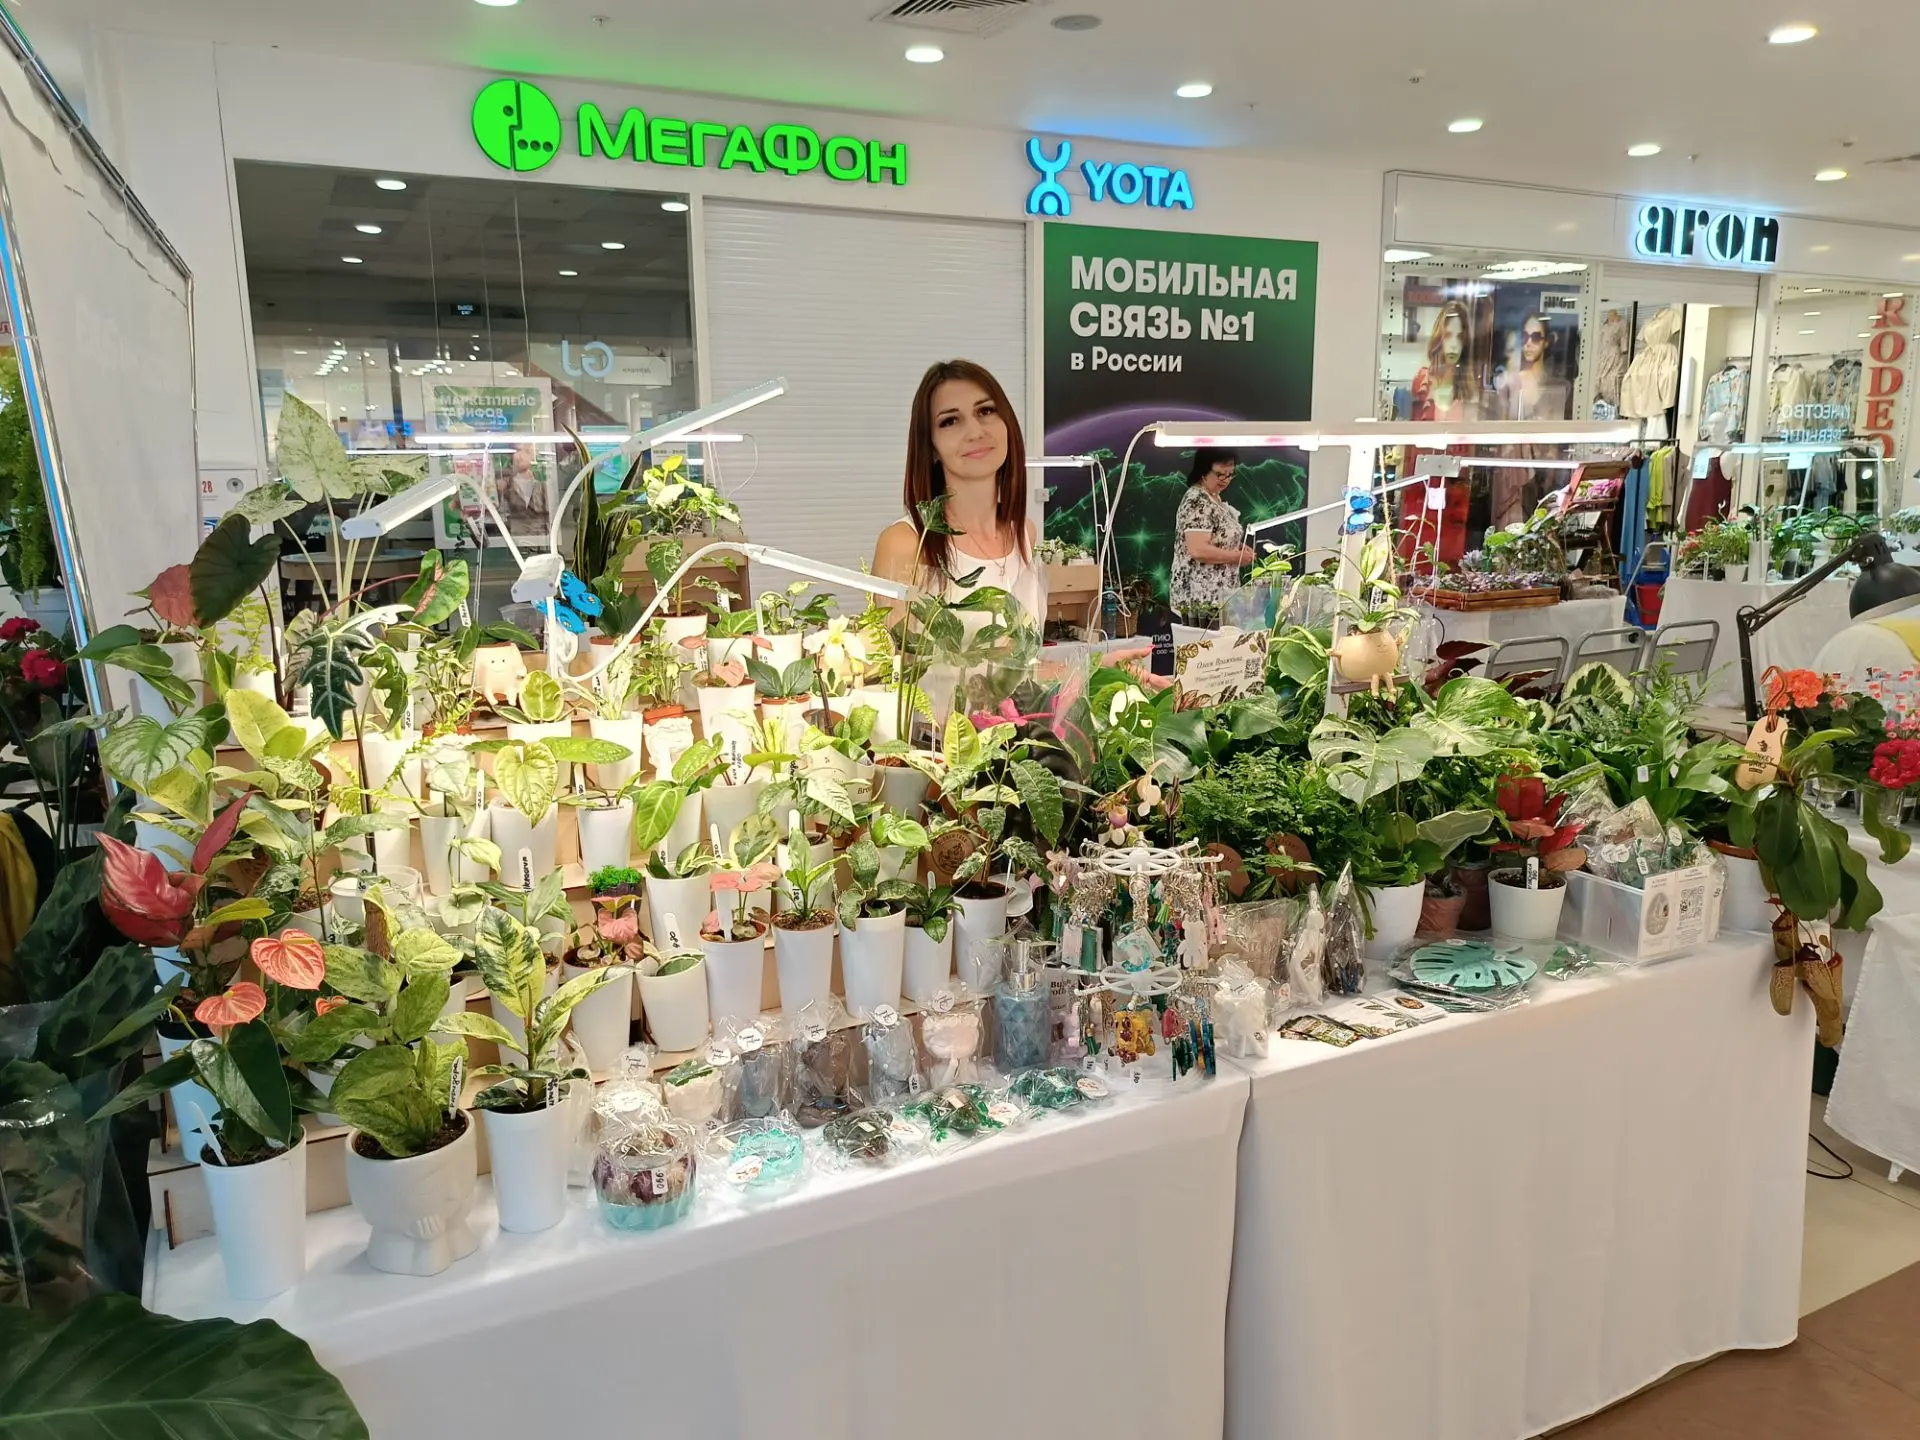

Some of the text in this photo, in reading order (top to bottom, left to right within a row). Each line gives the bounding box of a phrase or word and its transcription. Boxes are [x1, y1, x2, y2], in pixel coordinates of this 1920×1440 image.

[1080, 159, 1195, 210] YOTA
[1071, 255, 1298, 301] МОБИЛЬНАЯ
[1070, 302, 1255, 342] СВЯЗЬ №1
[1071, 346, 1183, 373] в России
[439, 394, 537, 408] МАРКЕТПЛЕЙС
[202, 480, 213, 493] 28
